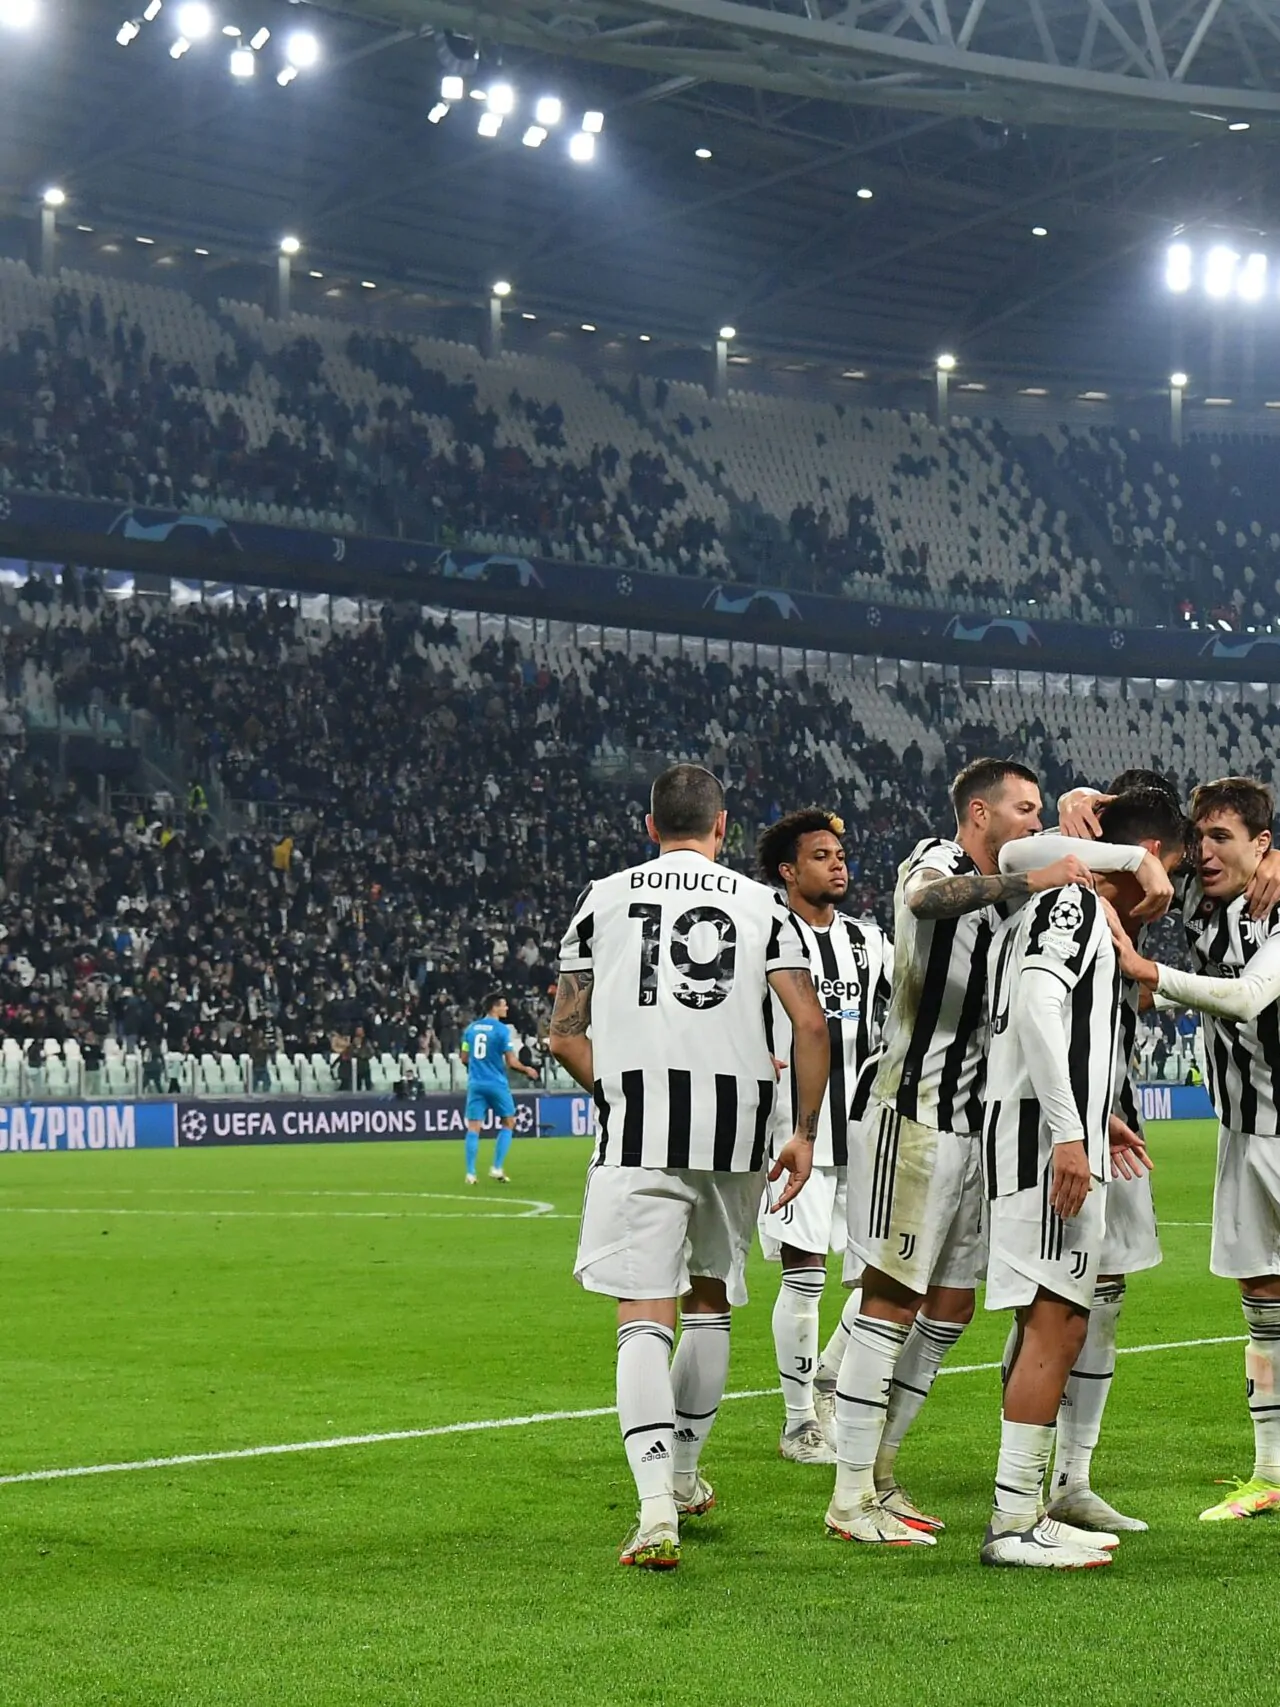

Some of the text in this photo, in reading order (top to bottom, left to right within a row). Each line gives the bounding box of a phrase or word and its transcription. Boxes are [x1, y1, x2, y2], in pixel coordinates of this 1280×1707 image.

[630, 871, 738, 895] BONUCCI
[628, 902, 738, 1011] 19
[473, 1033, 488, 1060] 6
[212, 1112, 278, 1136] UEFA
[282, 1109, 418, 1136] CHAMPIONS
[640, 1451, 670, 1463] adidas
